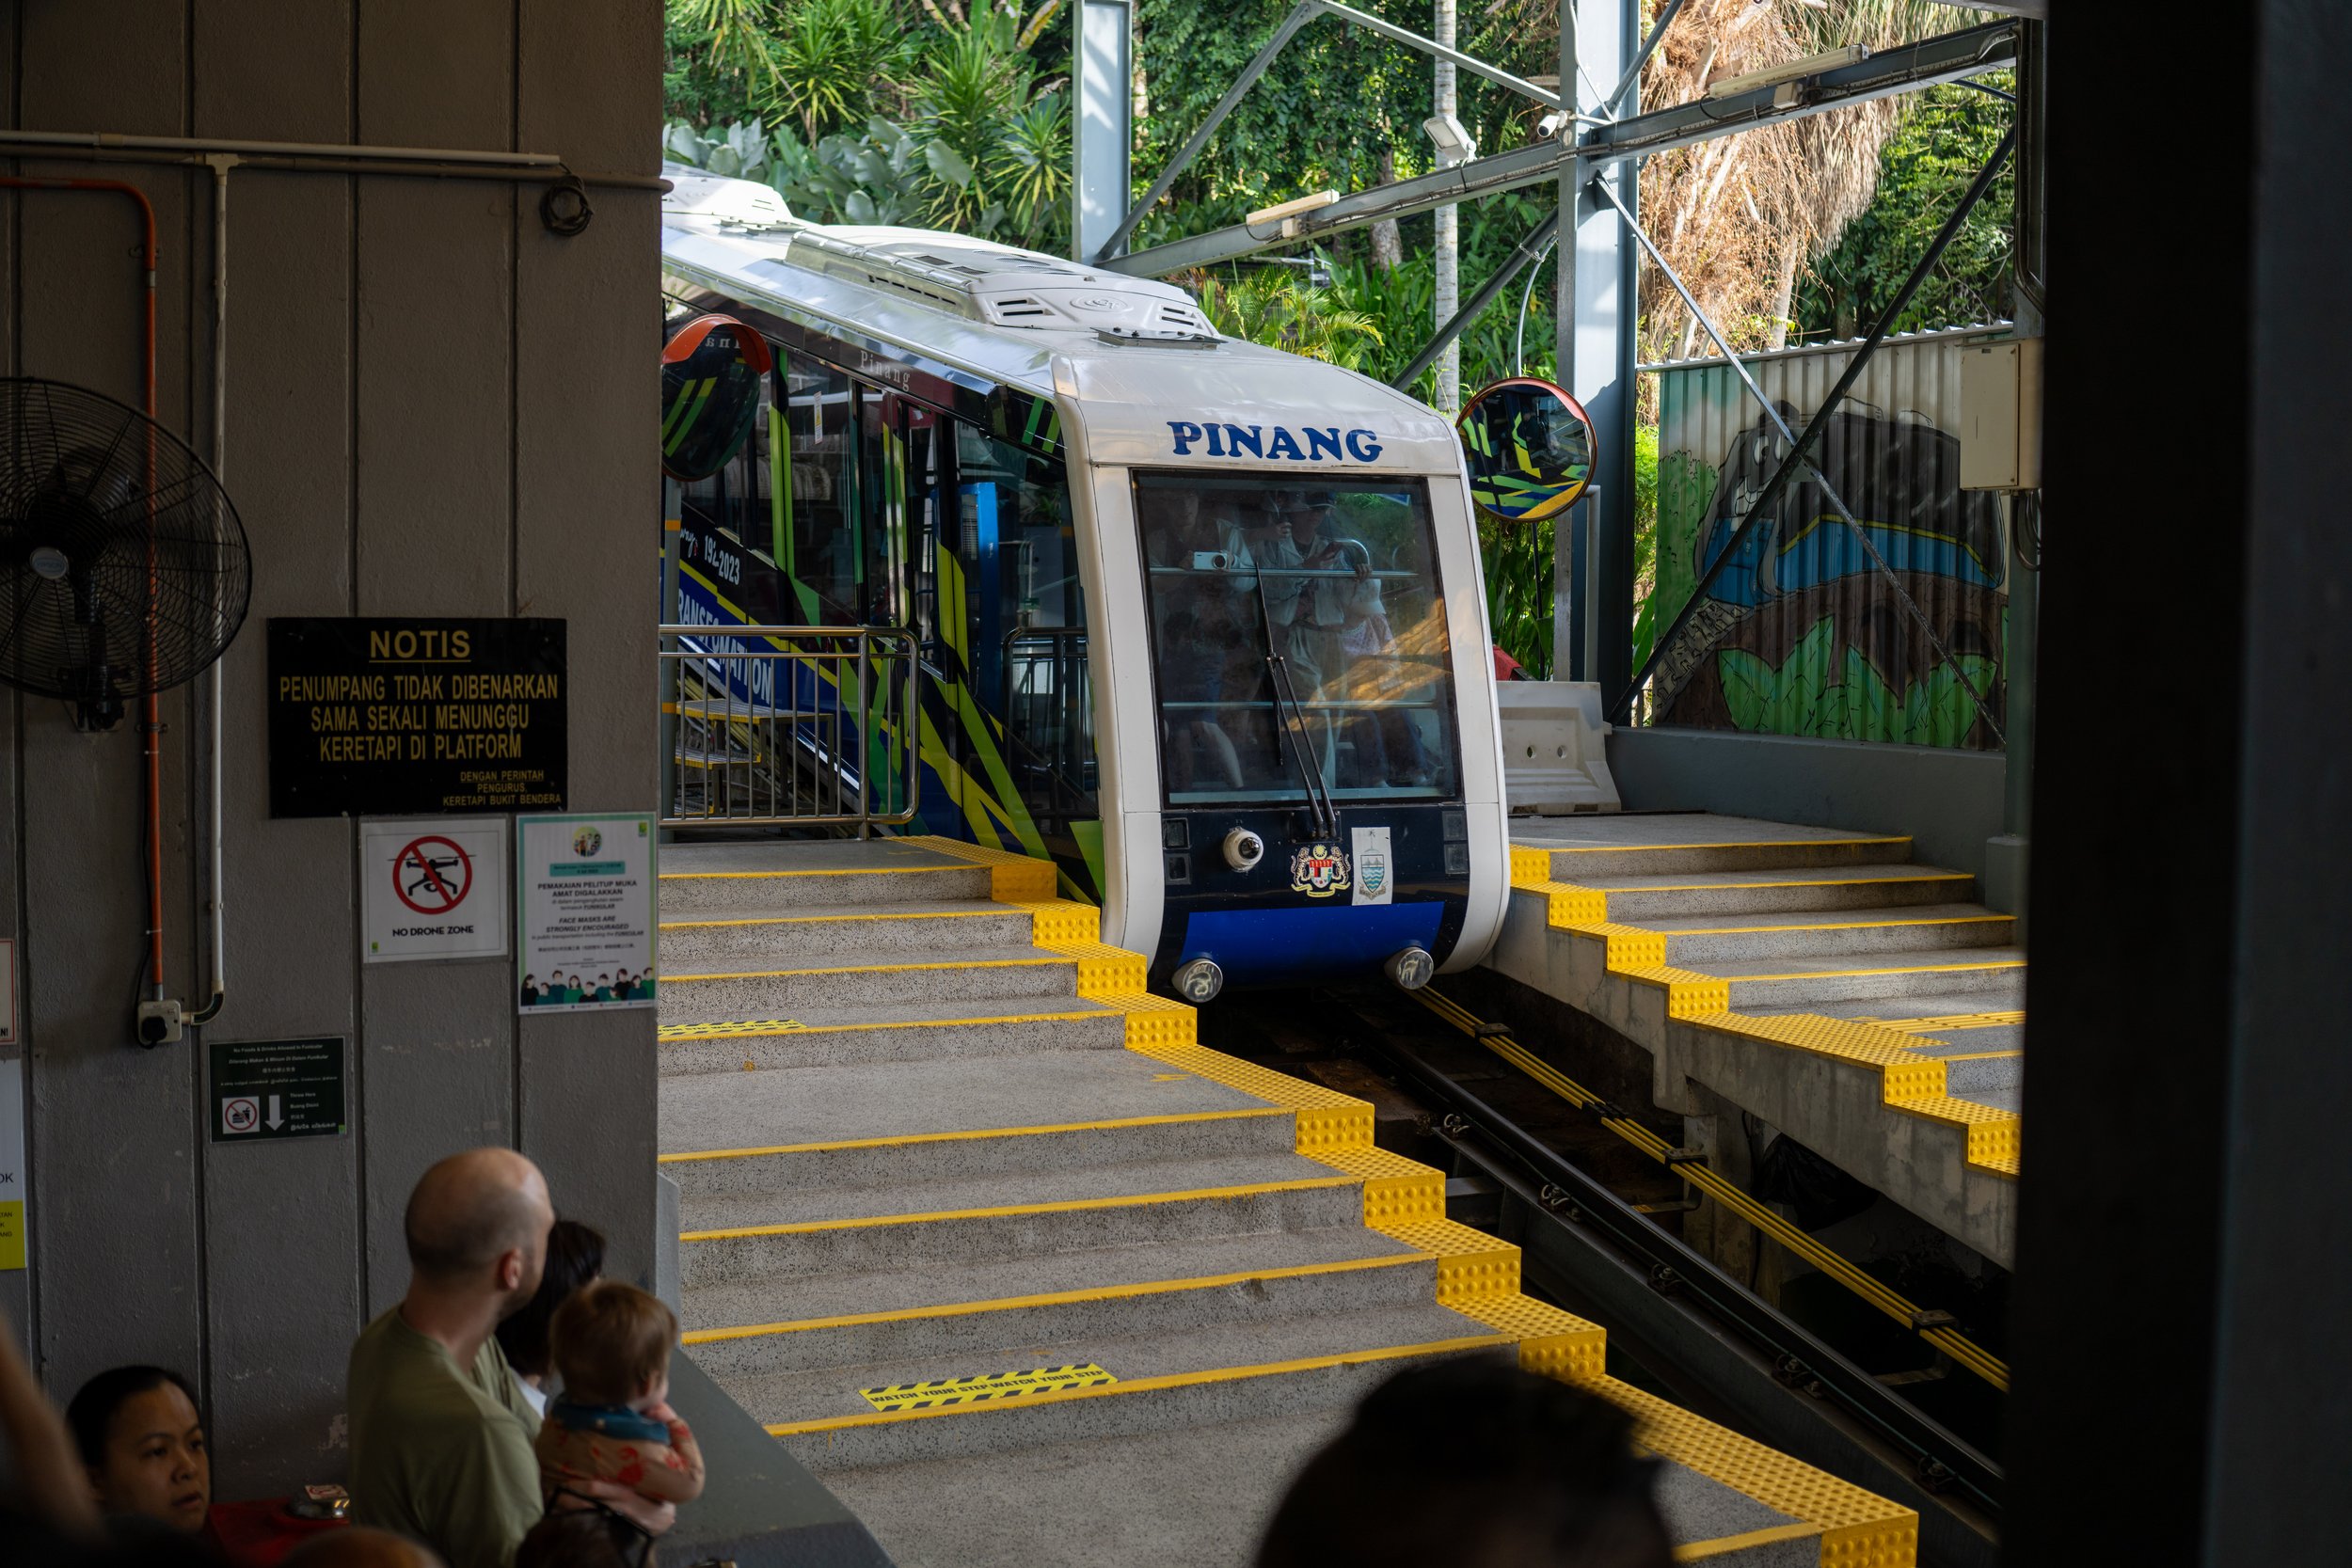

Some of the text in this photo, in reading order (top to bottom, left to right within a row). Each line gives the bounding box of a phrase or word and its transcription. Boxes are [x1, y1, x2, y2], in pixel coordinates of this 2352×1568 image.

[859, 350, 911, 391] Pinang
[1167, 420, 1383, 463] PINANG
[371, 629, 470, 658] NOTIS
[279, 673, 558, 702] PENUMPANG TIDAK DIBENARKAN
[310, 704, 530, 732] SAMA SEKALI MENUNGGU
[320, 733, 522, 762] KERETAPI DI PLATFORM
[460, 769, 544, 783] DENGAN PERINTAH
[443, 794, 562, 806] KERETAPI BUKIT BENDERA
[392, 925, 474, 937] NO DRONE ZONE
[871, 1370, 1104, 1403] WATCH YOUR STEP WATCH YOUR STEP
